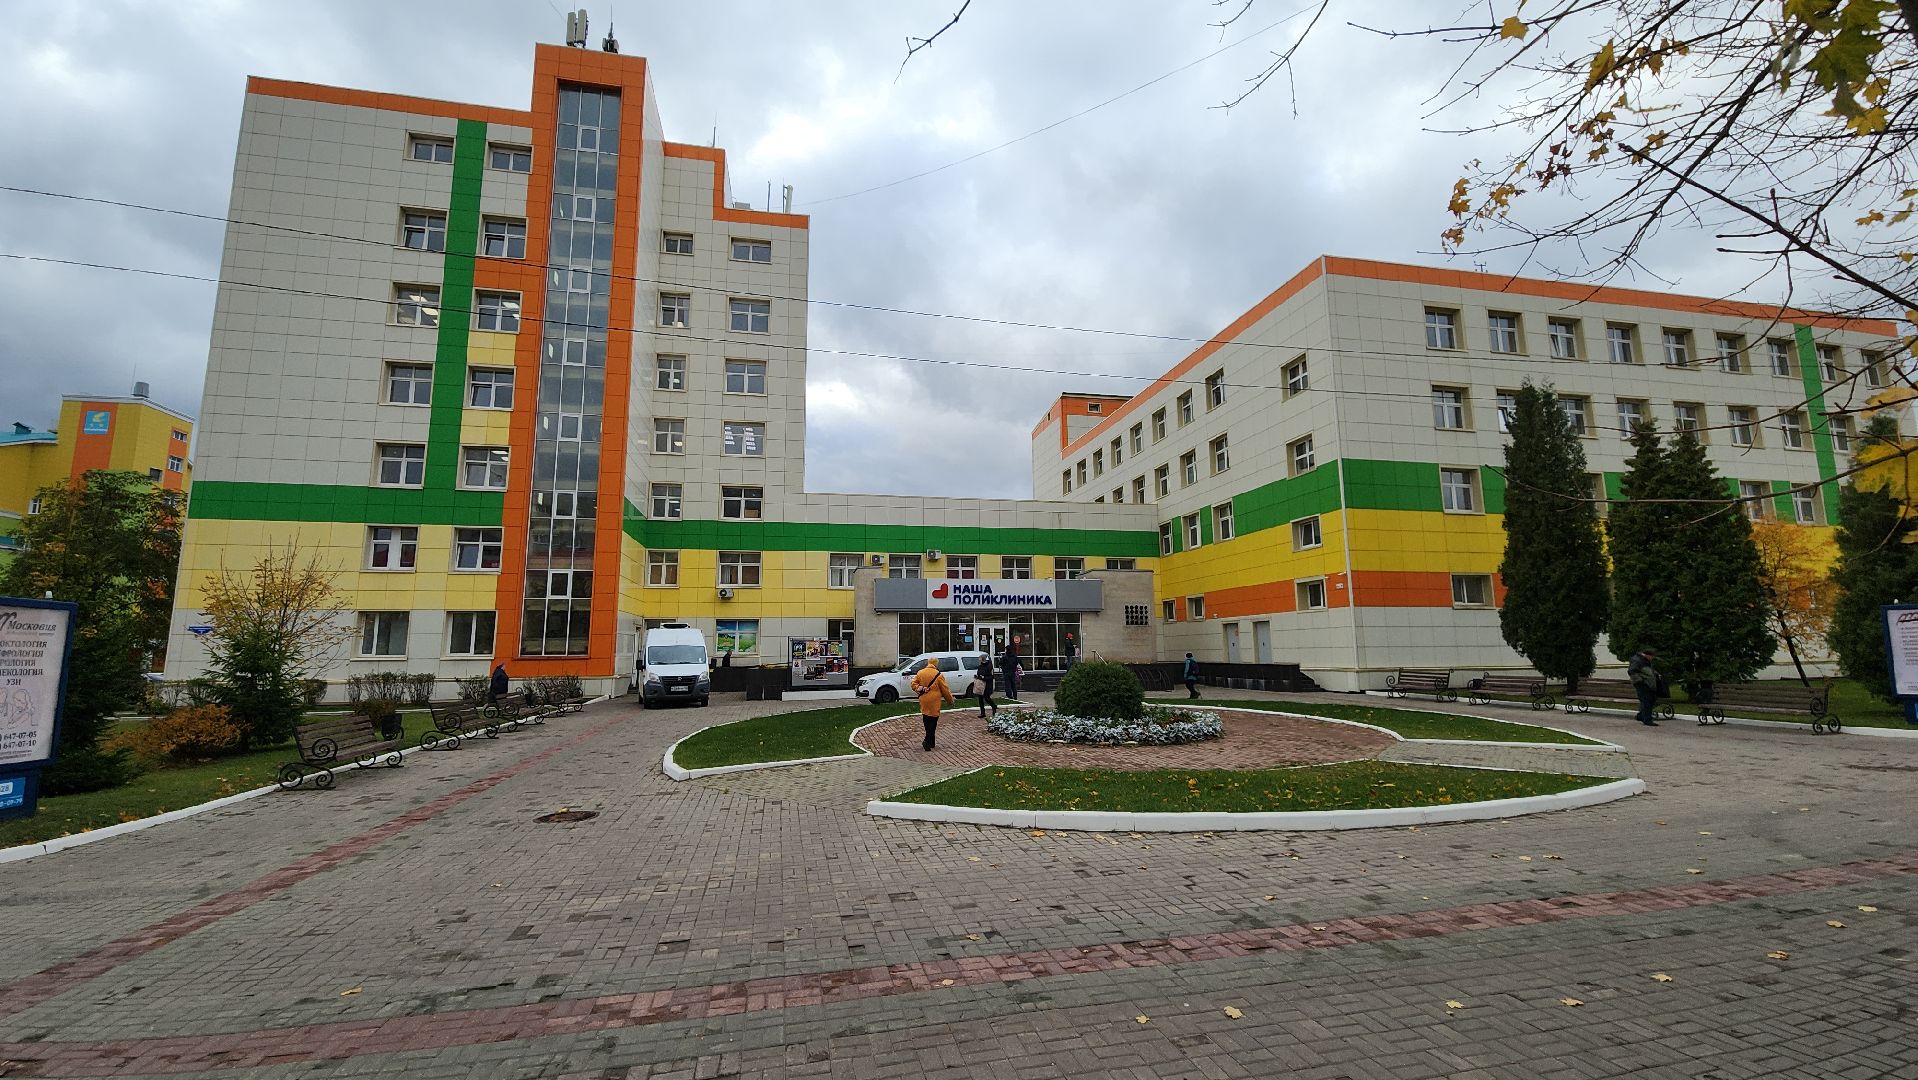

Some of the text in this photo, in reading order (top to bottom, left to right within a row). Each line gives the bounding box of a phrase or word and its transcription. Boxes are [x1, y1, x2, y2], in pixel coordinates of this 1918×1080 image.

[953, 584, 992, 594] НАША
[953, 594, 1052, 605] ПОЛИКЛИНИКА
[7, 620, 57, 631] Московия
[0, 649, 44, 657] ФРОЛОГИЯ
[6, 678, 22, 686] УЗИ
